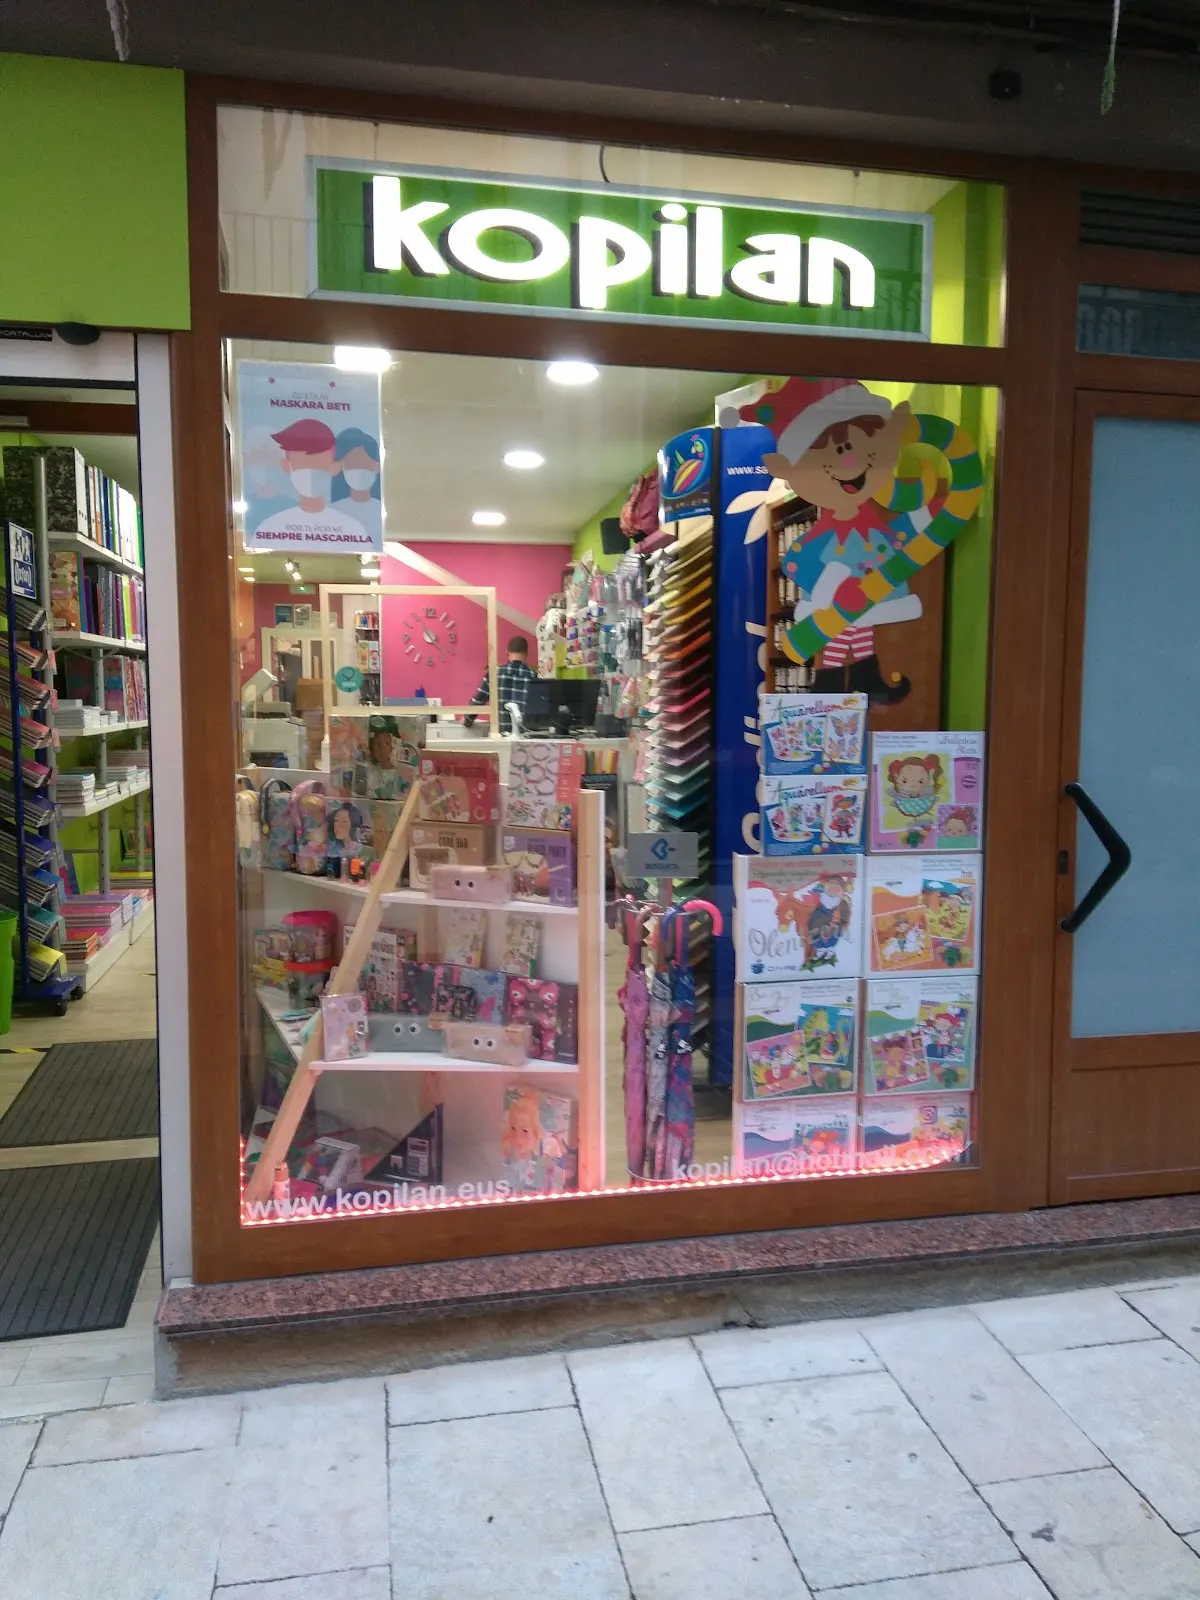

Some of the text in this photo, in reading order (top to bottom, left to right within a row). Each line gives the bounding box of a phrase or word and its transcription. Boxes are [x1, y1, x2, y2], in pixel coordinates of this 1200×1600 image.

[371, 174, 876, 311] kopilan
[270, 398, 351, 411] MASKARA BETI
[256, 531, 373, 543] SIEMPRE MASCARILLA
[247, 1178, 512, 1219] www.kopilan.eus
